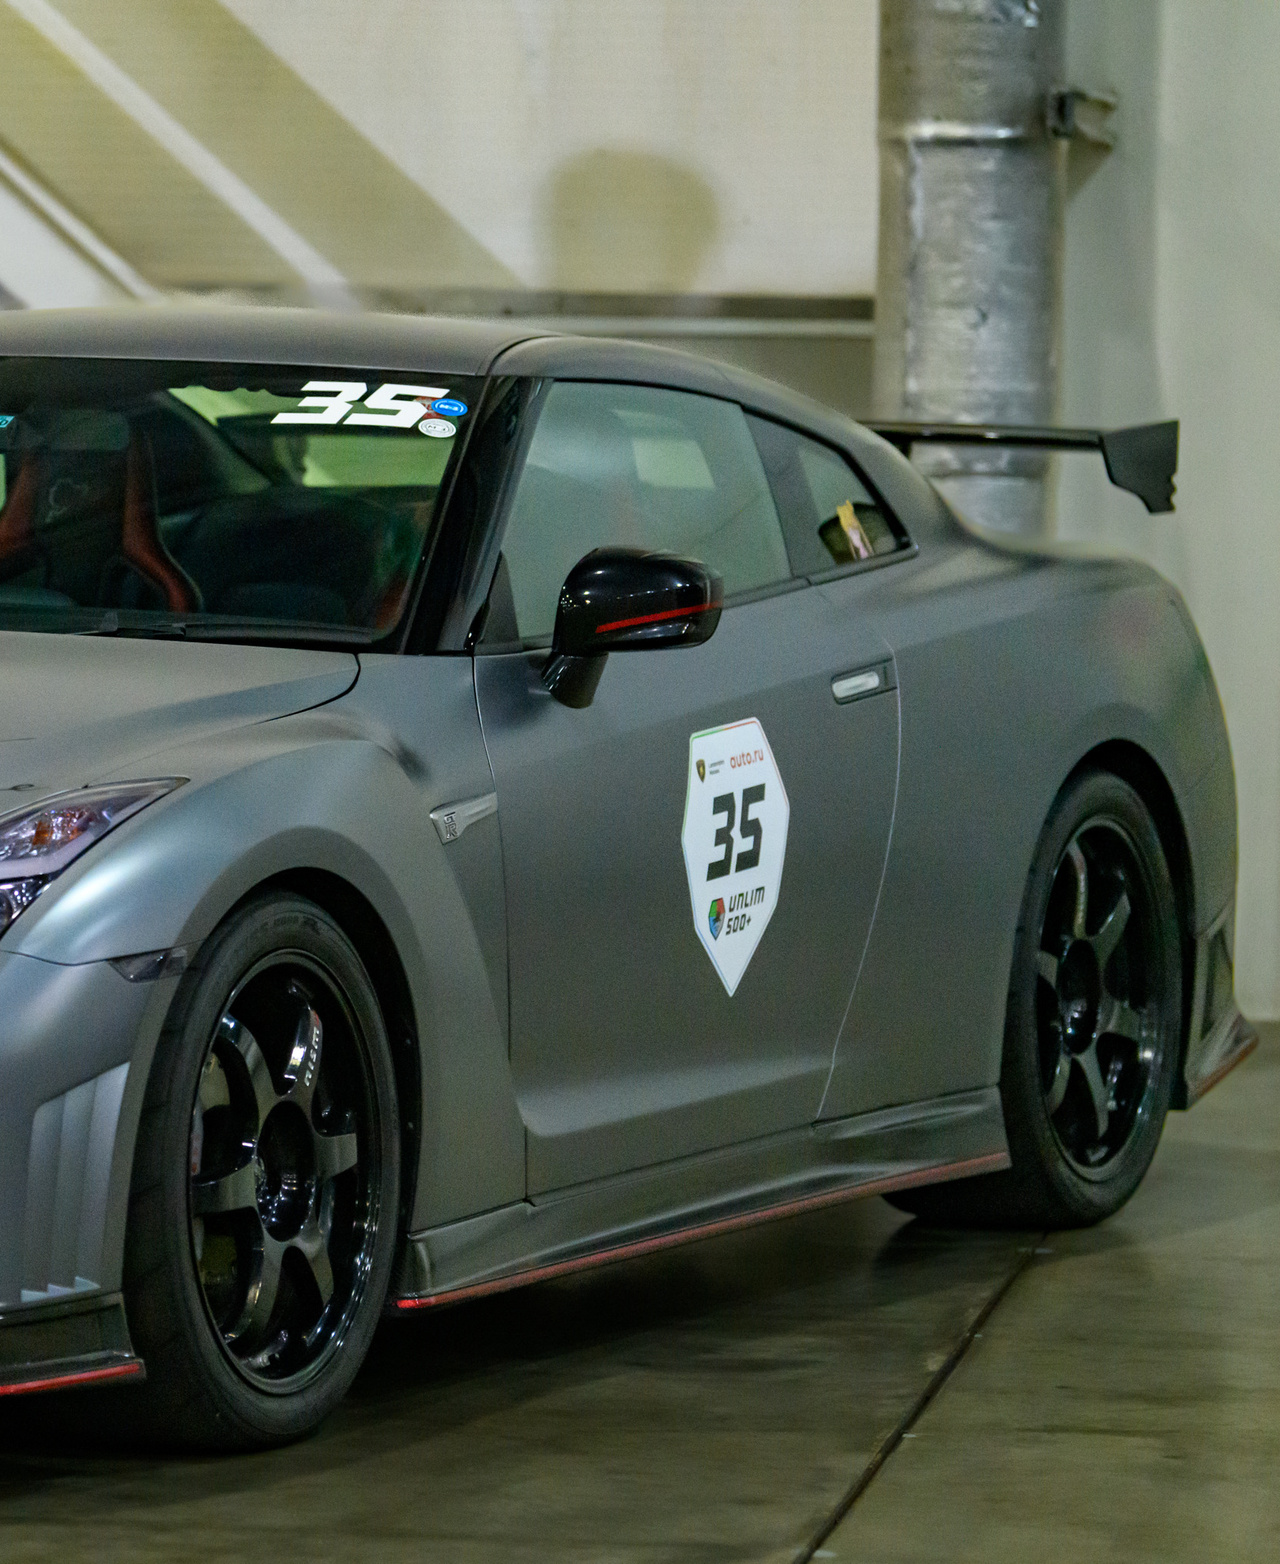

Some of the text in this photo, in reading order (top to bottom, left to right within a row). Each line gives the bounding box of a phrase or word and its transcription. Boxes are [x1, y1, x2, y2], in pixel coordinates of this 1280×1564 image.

[270, 380, 451, 429] 35
[730, 749, 764, 769] auto.ru
[706, 783, 766, 882] 35
[729, 886, 765, 913] UNLIM
[725, 913, 751, 936] 500+
